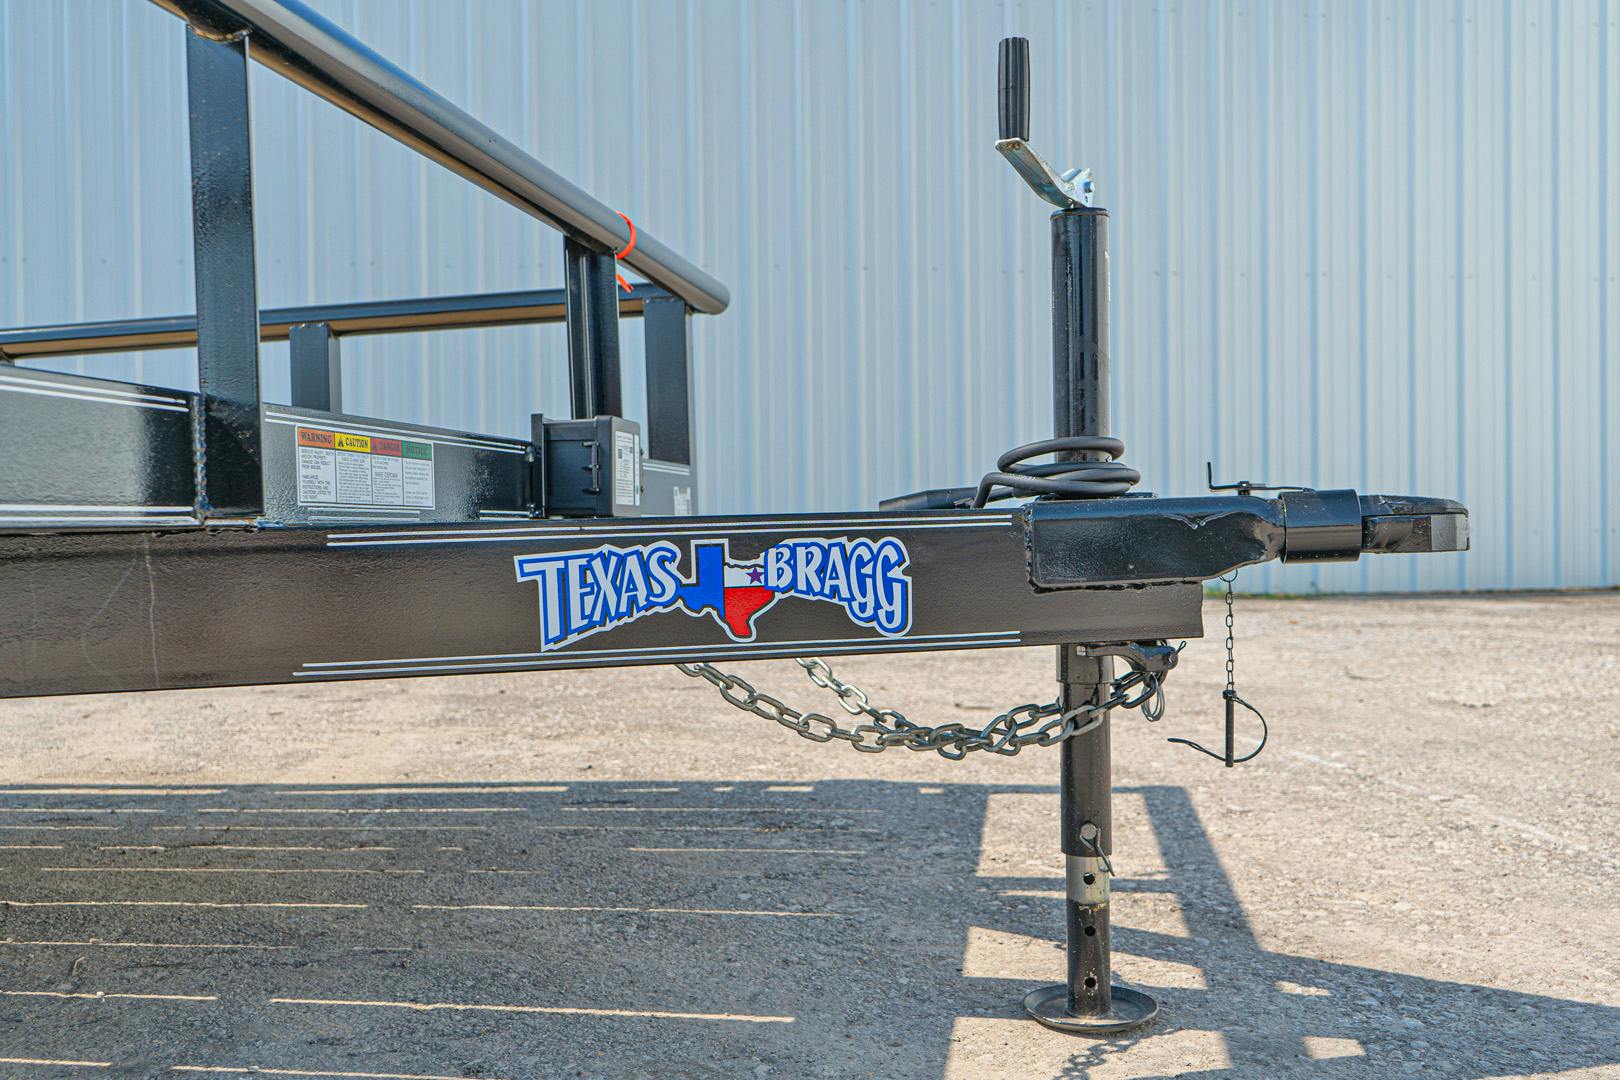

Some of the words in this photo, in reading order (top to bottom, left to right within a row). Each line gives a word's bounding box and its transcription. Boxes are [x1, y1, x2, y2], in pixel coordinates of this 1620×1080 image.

[301, 431, 332, 445] WARNING
[345, 437, 368, 449] CAUTION
[516, 546, 678, 646] TEXAS
[763, 540, 908, 634] BRAGG
